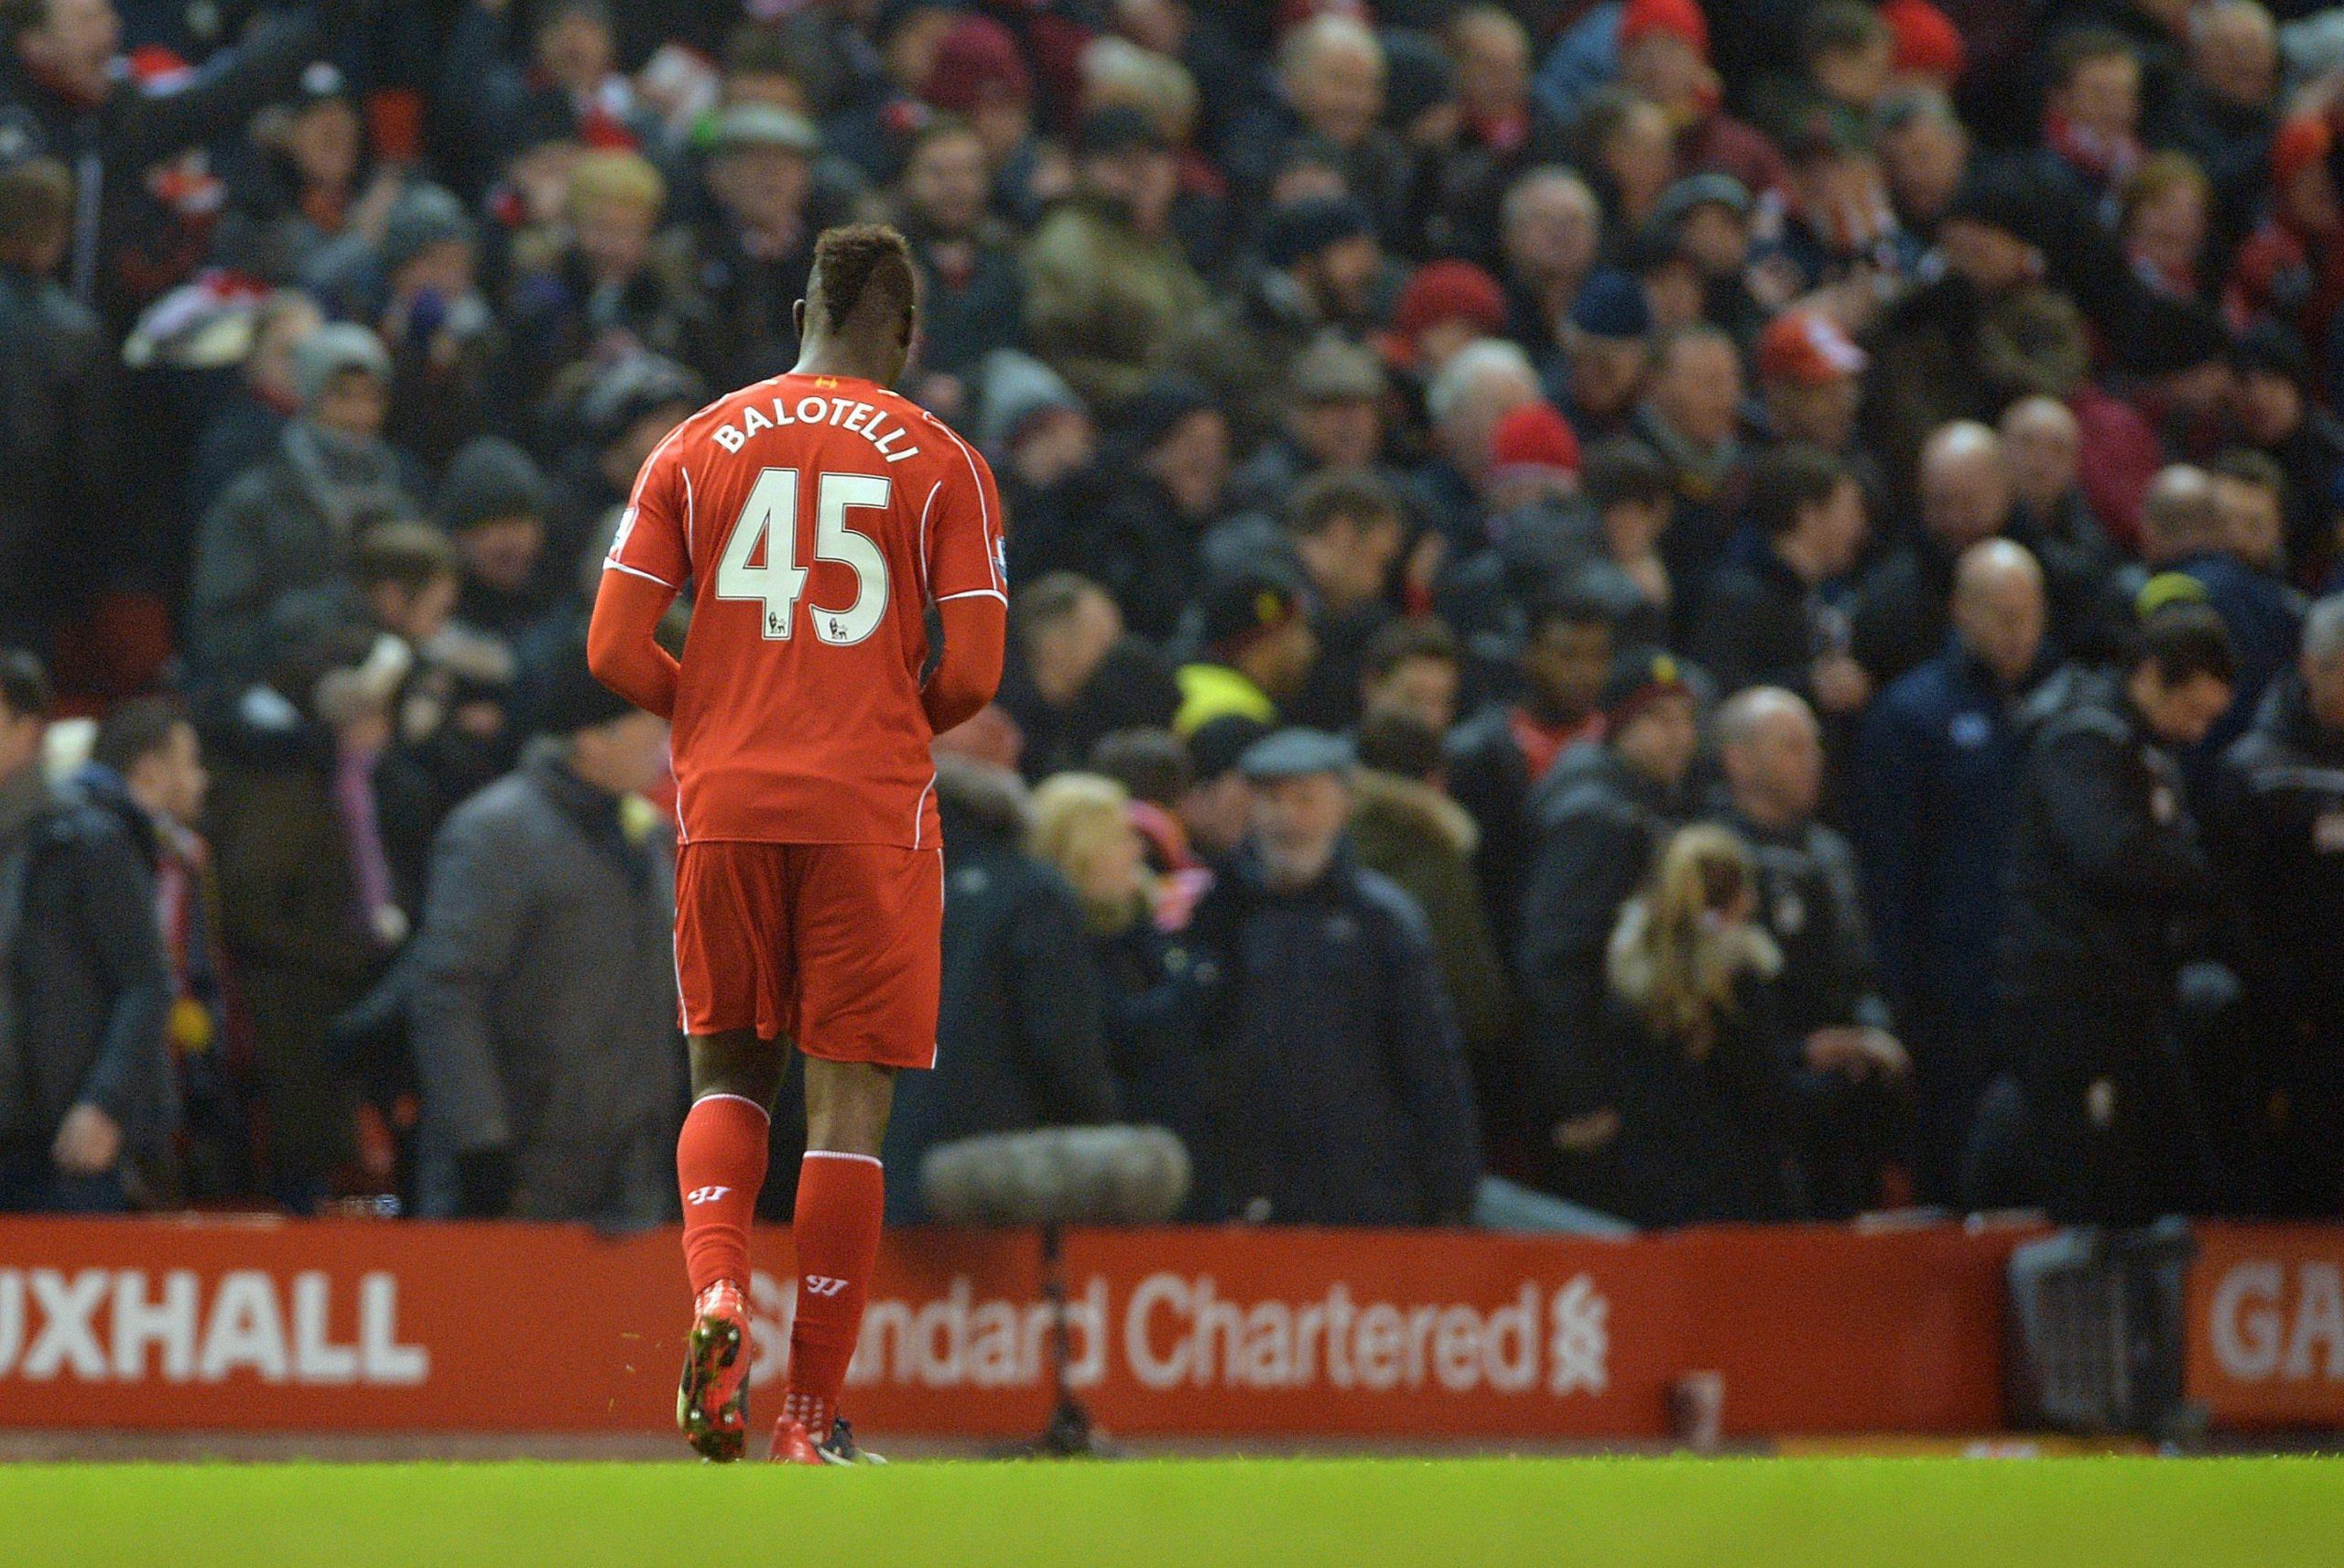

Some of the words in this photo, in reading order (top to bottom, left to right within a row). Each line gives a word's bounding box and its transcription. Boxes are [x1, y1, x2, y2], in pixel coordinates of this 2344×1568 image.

[713, 396, 918, 462] BALOTELLI
[716, 468, 891, 644] 45
[748, 1272, 1106, 1387] Sndard
[1125, 1274, 1541, 1388] Chartered
[2211, 1261, 2344, 1379] GA
